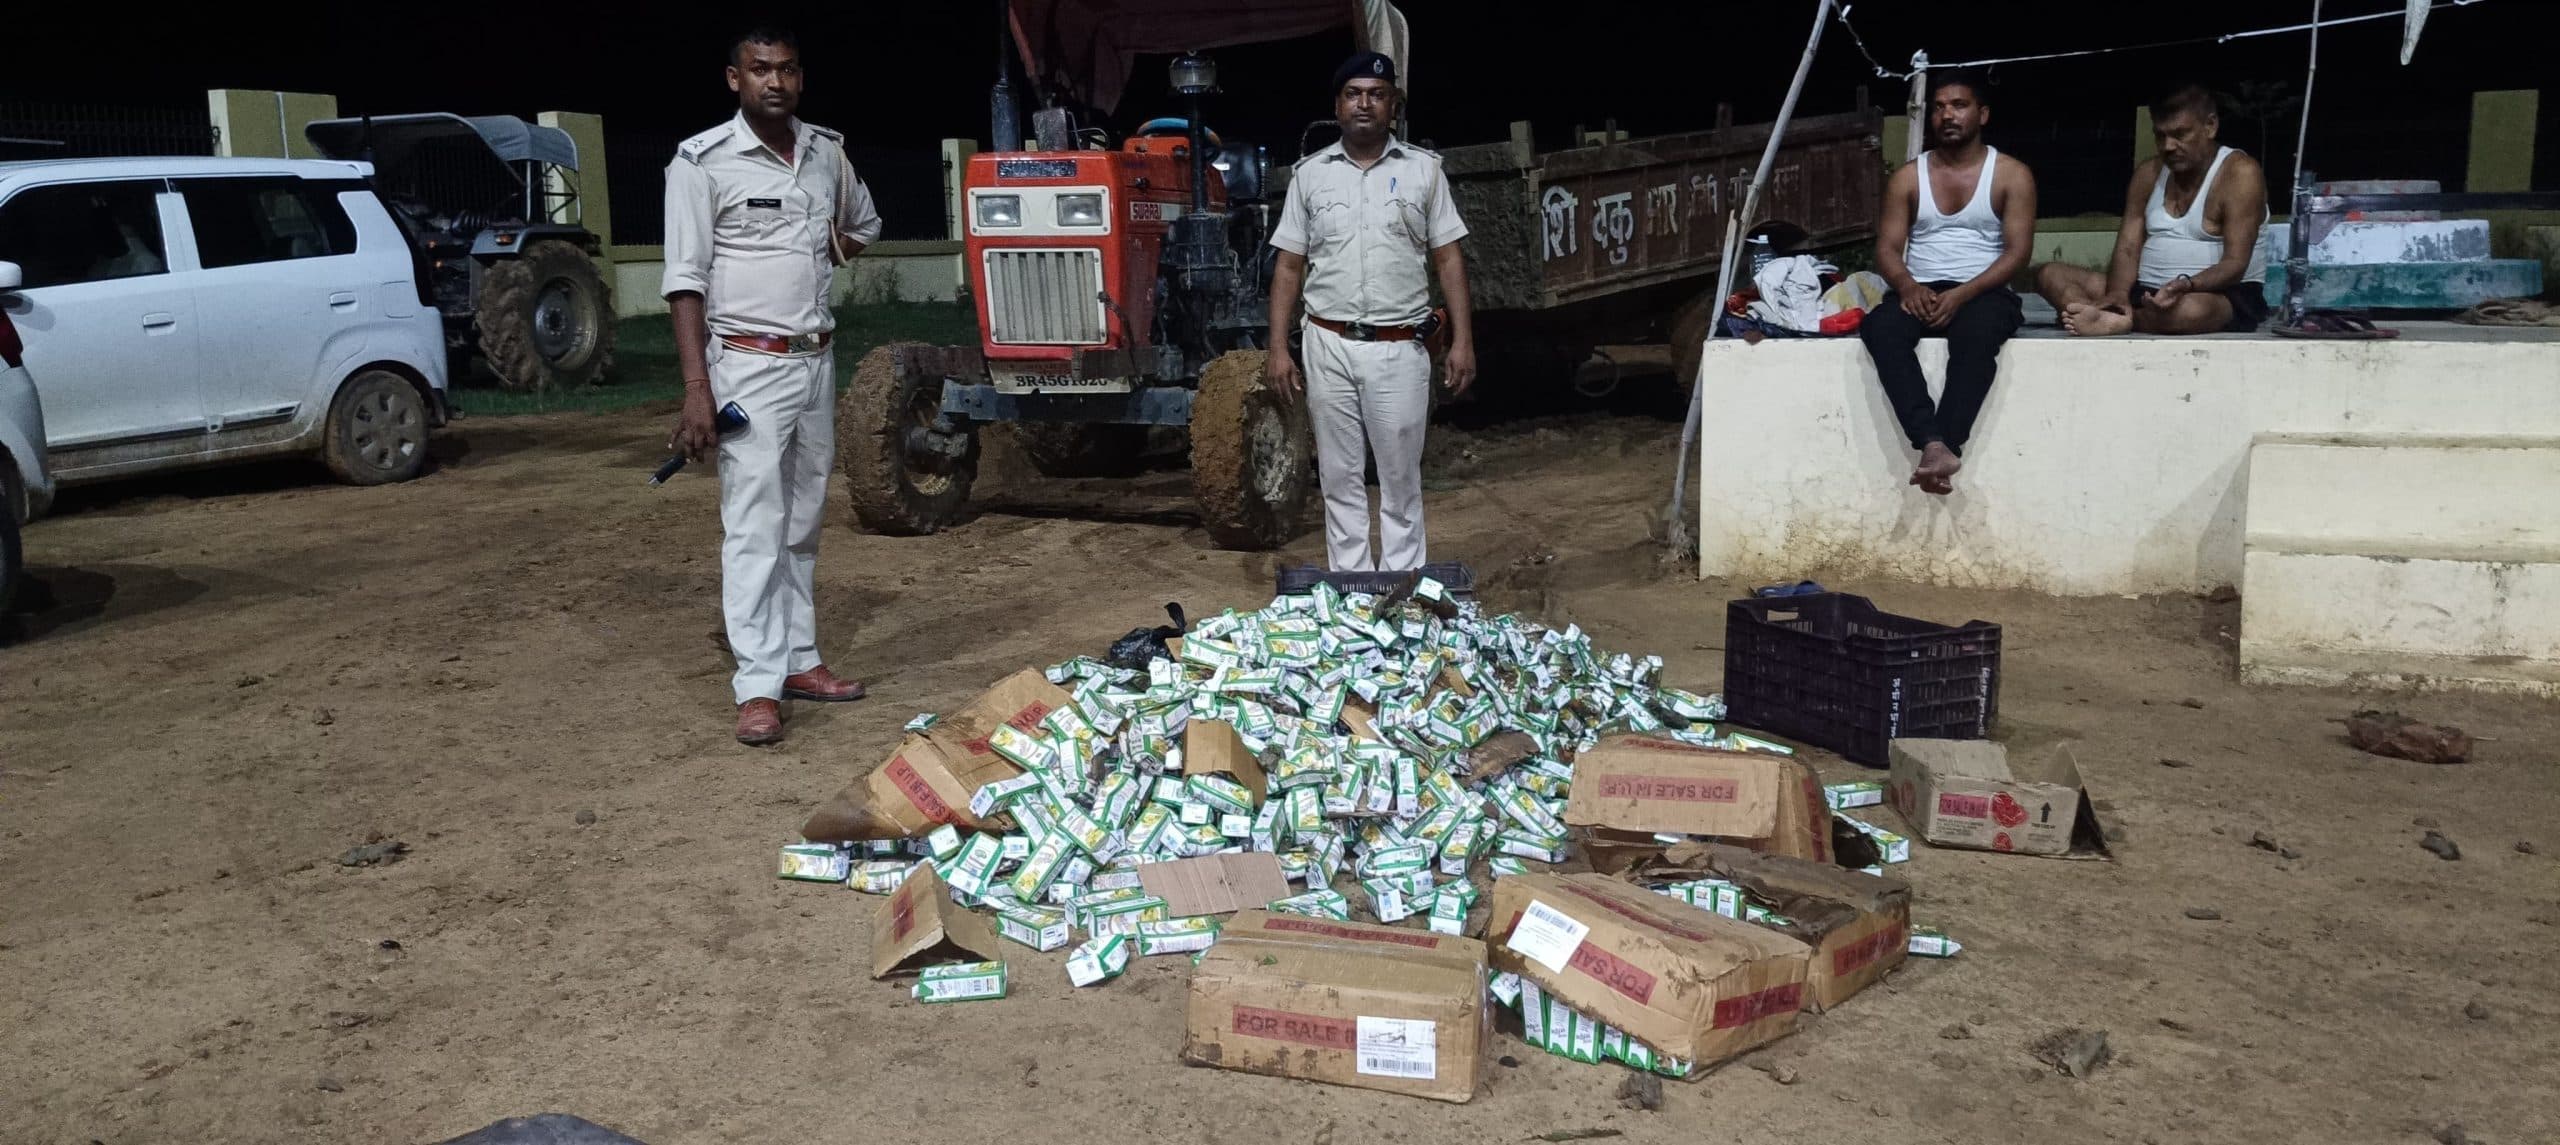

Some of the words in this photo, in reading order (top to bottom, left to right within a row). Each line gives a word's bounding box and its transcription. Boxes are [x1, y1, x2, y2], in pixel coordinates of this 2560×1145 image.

[1636, 783, 1651, 797] IN
[1655, 784, 1696, 799] SALE
[1700, 785, 1734, 800] FOR
[1609, 965, 1652, 998] FOR
[1236, 1012, 1279, 1035] FOR
[1284, 1020, 1338, 1043] SALE
